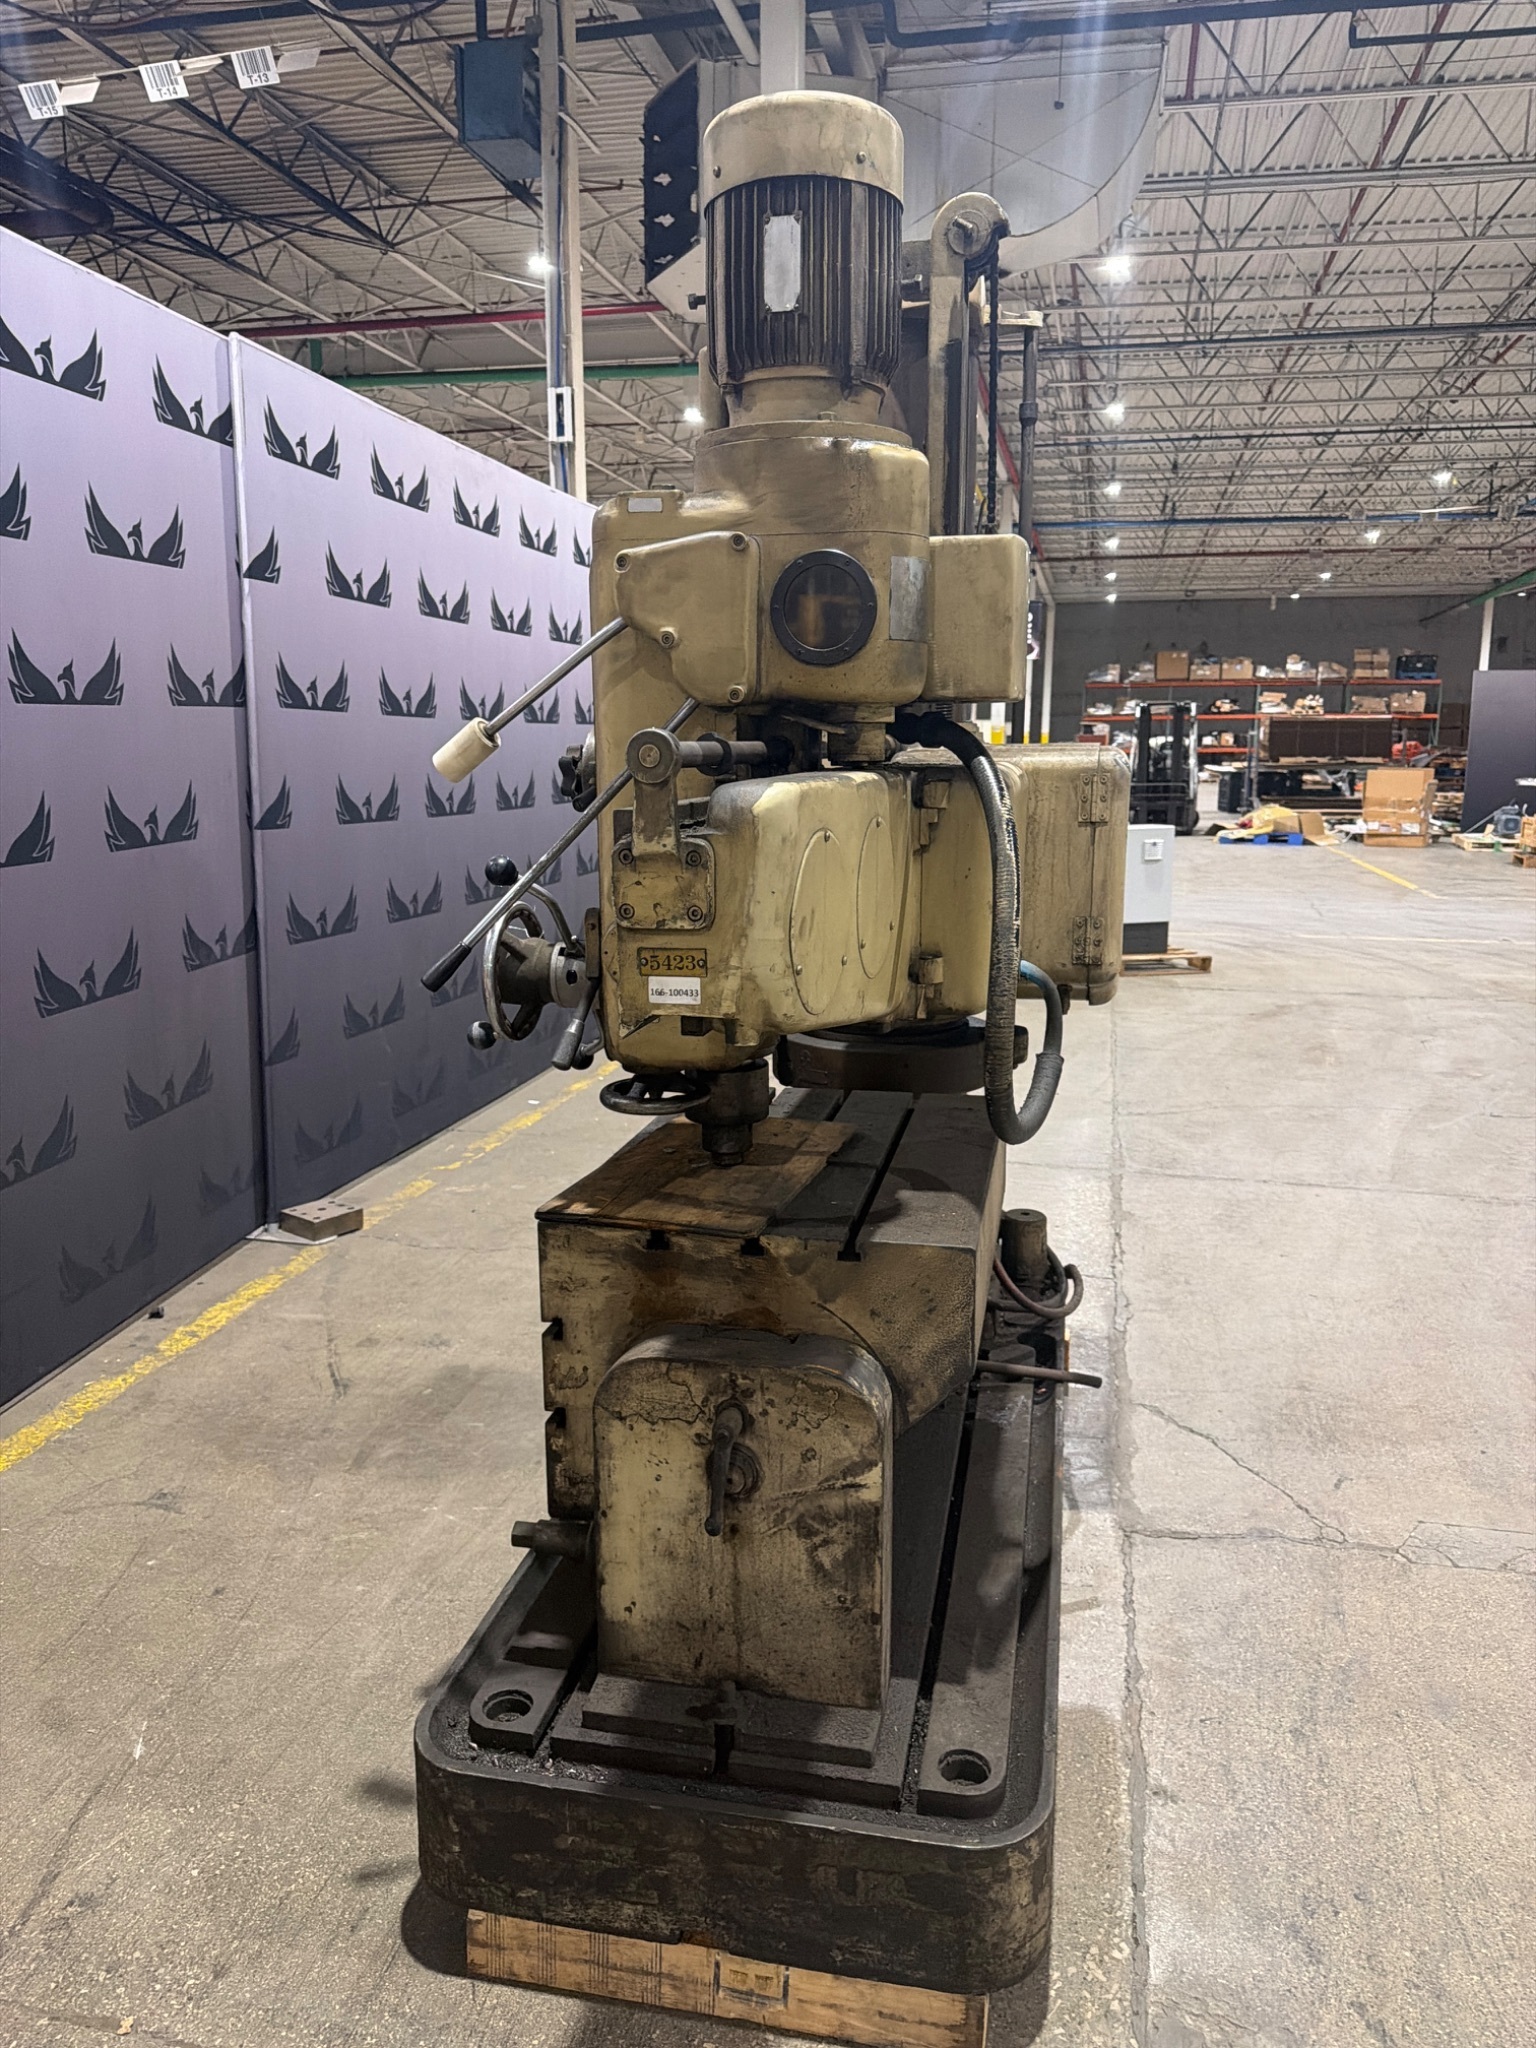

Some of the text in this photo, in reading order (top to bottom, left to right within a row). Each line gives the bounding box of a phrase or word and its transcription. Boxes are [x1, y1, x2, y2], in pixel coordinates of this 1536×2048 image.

[246, 73, 270, 86] T-13
[156, 86, 179, 99] T-14
[37, 105, 59, 117] T-15
[649, 954, 697, 971] 5423
[650, 987, 699, 998] 166-100433
